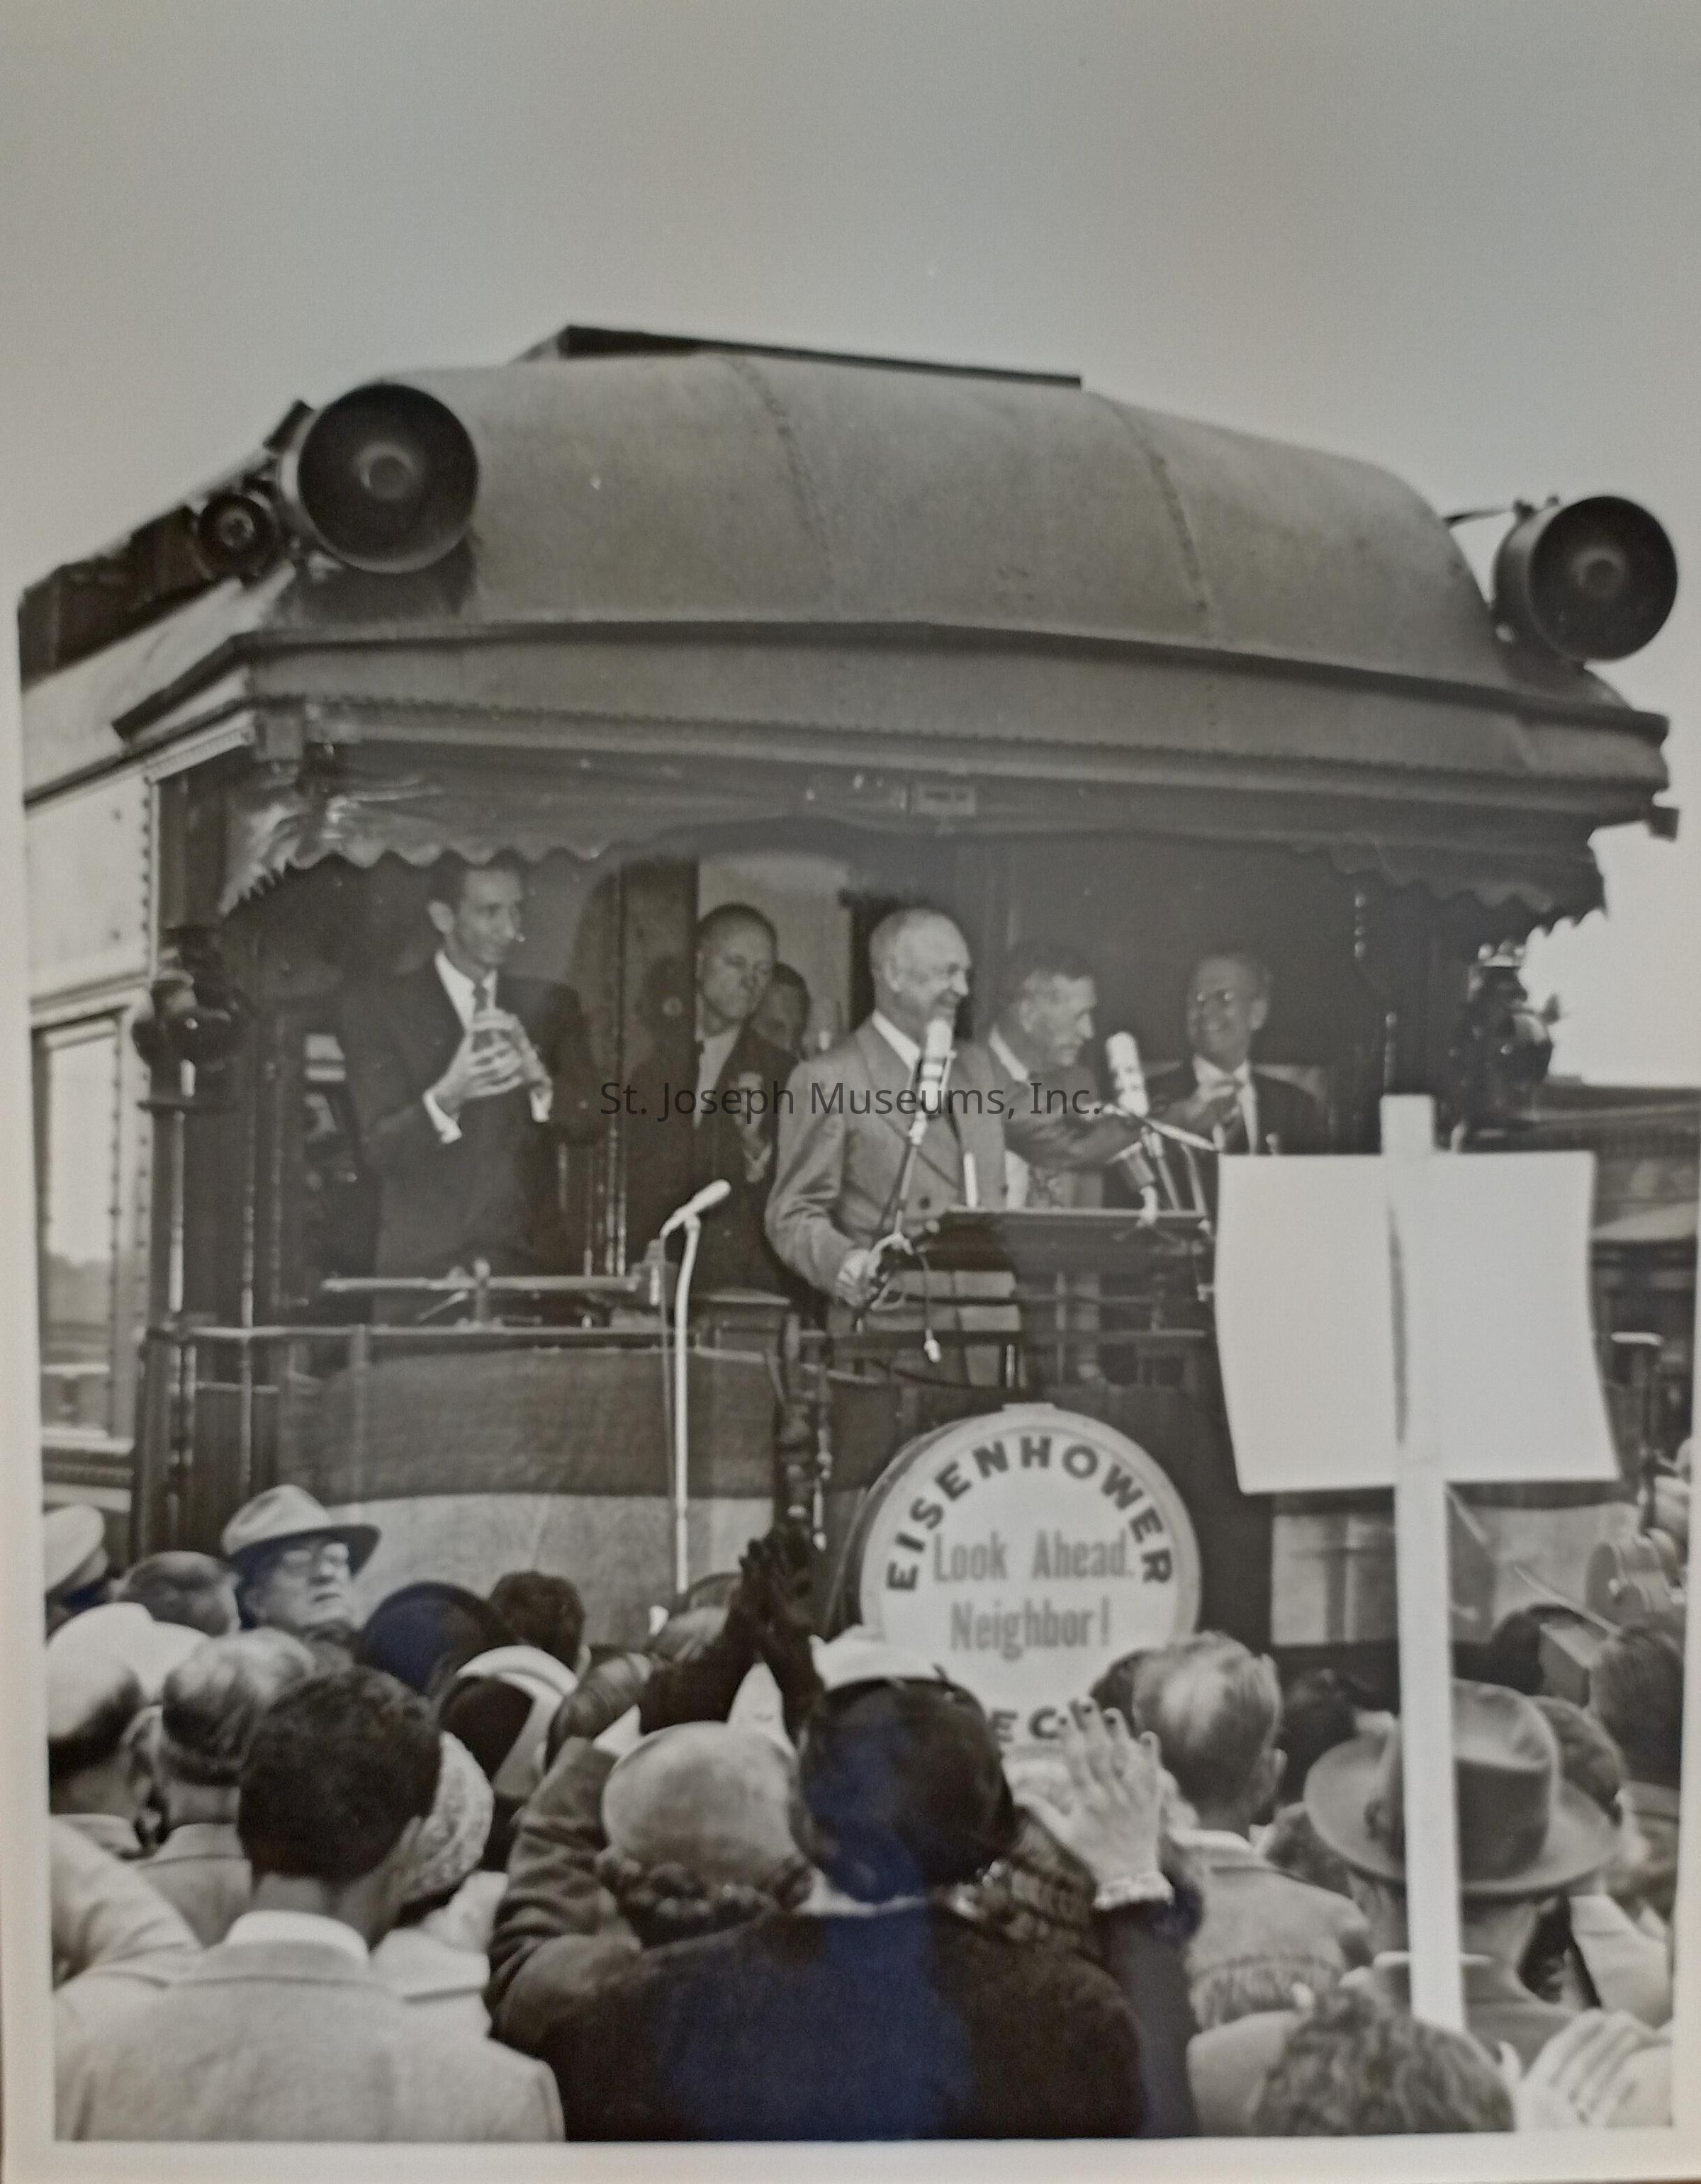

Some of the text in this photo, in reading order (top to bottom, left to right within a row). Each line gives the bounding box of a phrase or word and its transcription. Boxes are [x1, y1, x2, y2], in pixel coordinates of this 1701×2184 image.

[886, 1436, 1173, 1592] EISENHOWER
[932, 1531, 1008, 1582] Look
[950, 1594, 1111, 1661] Neighbor!
